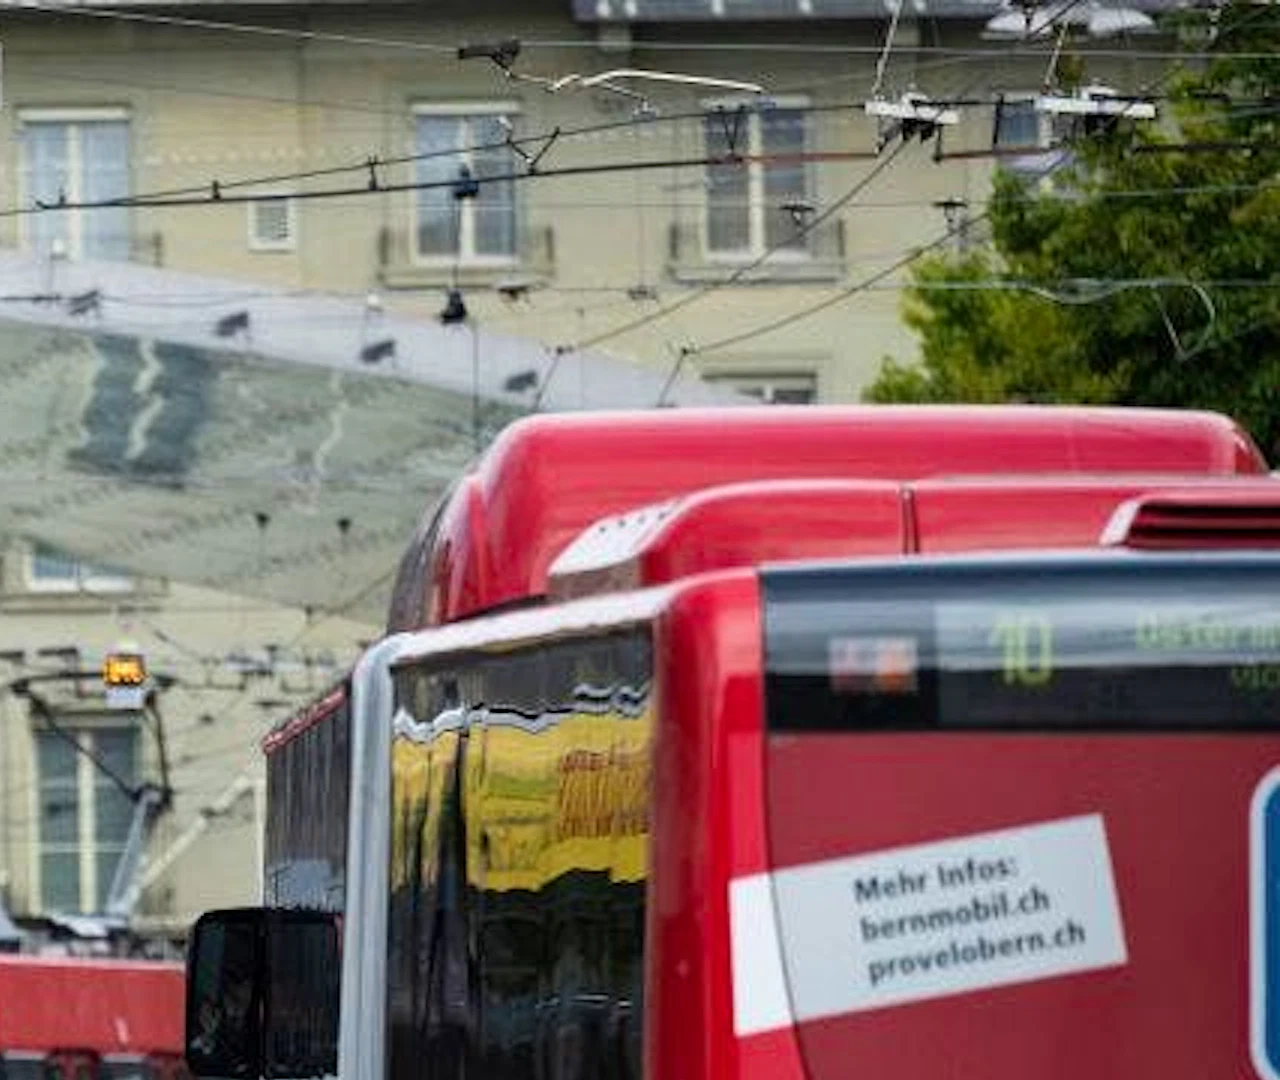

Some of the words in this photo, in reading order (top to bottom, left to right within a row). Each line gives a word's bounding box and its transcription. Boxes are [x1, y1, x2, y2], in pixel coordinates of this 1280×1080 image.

[991, 610, 1055, 686] 10
[854, 869, 927, 902] Mehr
[938, 857, 1019, 887] Infos:
[860, 885, 1051, 942] bernmobil.ch
[868, 917, 1086, 988] provelobern.ch
